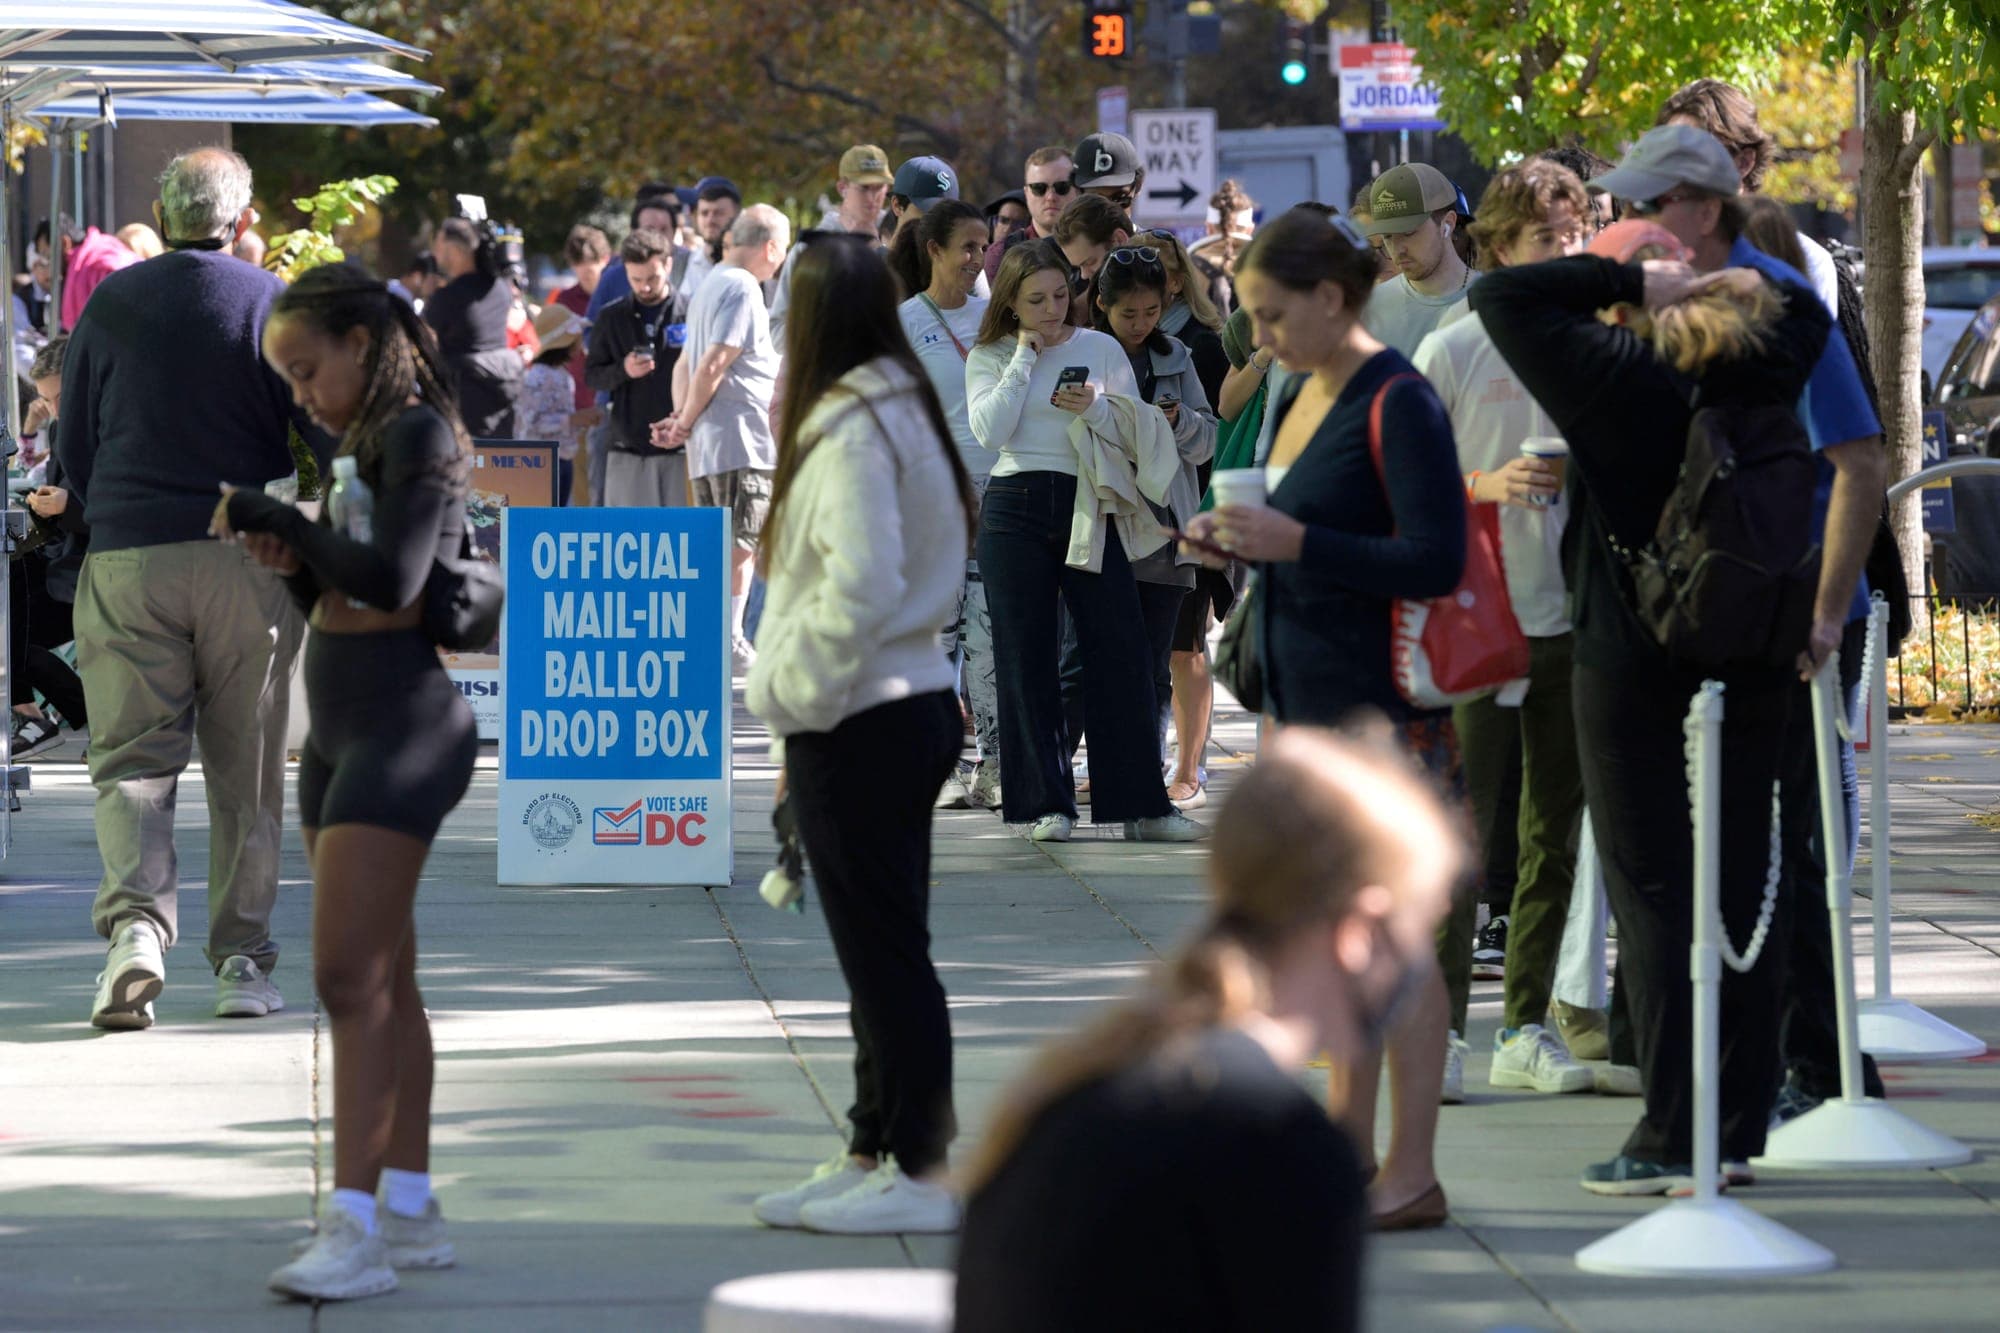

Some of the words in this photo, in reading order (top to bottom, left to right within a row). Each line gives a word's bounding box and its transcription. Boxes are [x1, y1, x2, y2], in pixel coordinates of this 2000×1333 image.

[1147, 120, 1200, 145] ONE
[1146, 149, 1203, 173] WAY
[491, 455, 547, 468] MENU
[532, 532, 699, 580] OFFICIAL
[543, 591, 686, 639] MAIL-IN
[545, 651, 685, 698] BALLOT
[521, 709, 619, 757] DROP
[636, 709, 709, 757] BOX
[522, 799, 539, 825] BOARD
[539, 793, 550, 801] OF
[552, 792, 583, 825] ELECTIONS
[647, 797, 676, 812] VOTE
[679, 797, 708, 812] SAFE
[646, 813, 706, 847] DC
